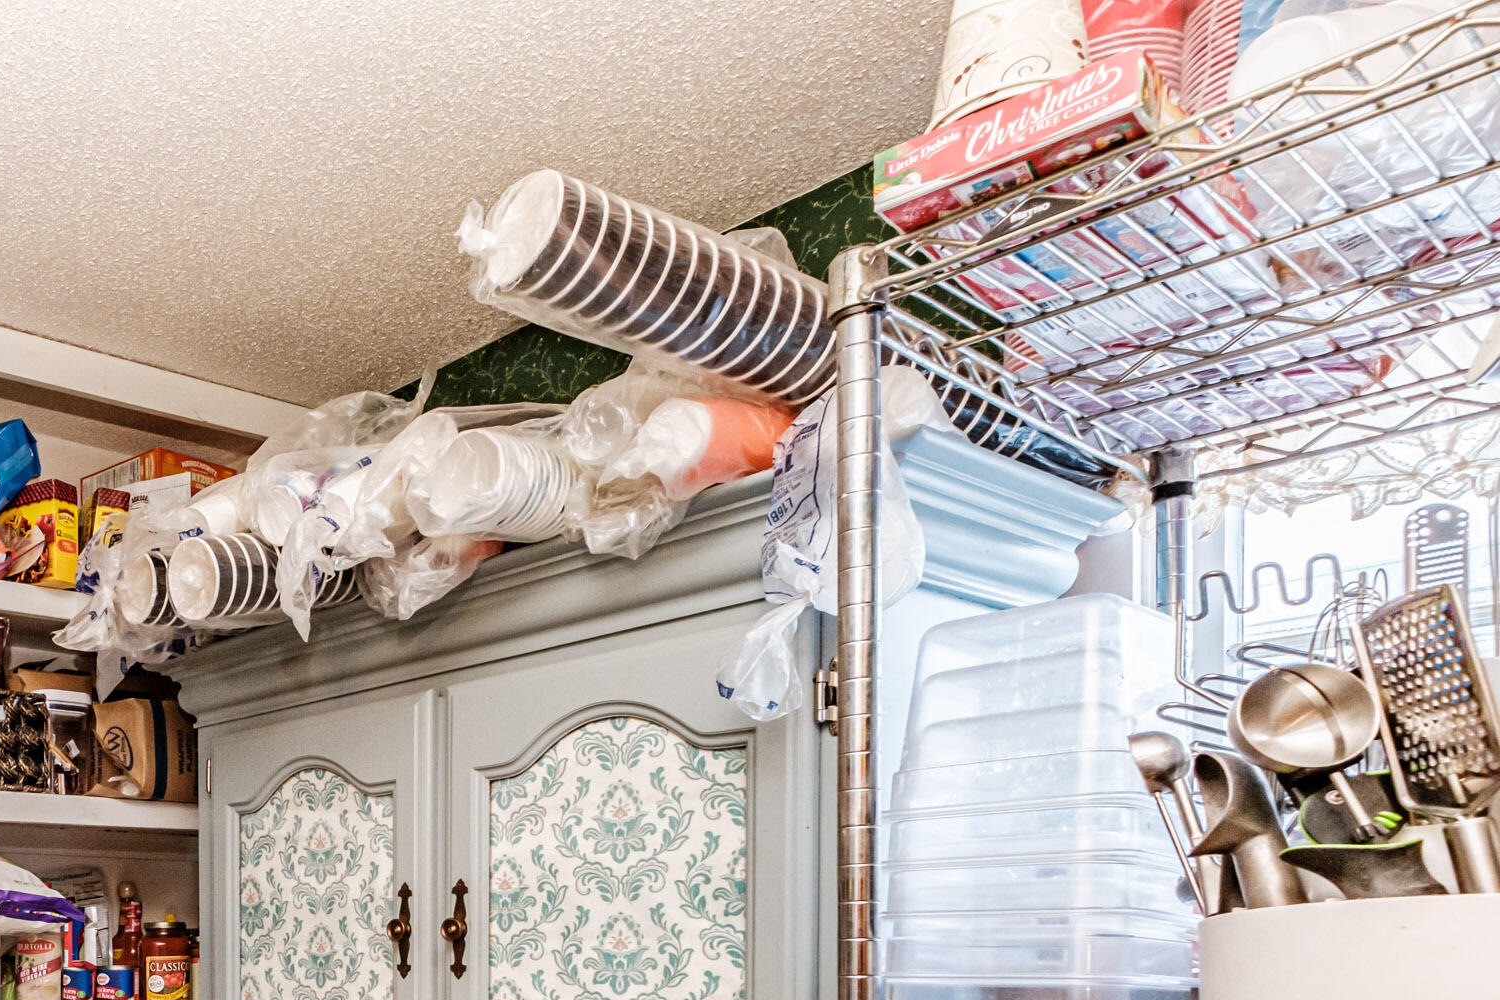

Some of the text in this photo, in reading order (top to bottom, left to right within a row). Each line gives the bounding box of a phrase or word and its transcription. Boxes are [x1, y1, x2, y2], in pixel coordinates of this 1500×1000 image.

[965, 63, 1122, 163] Christmas
[1028, 95, 1109, 135] TREE CAKES
[888, 130, 961, 174] Little Debbie
